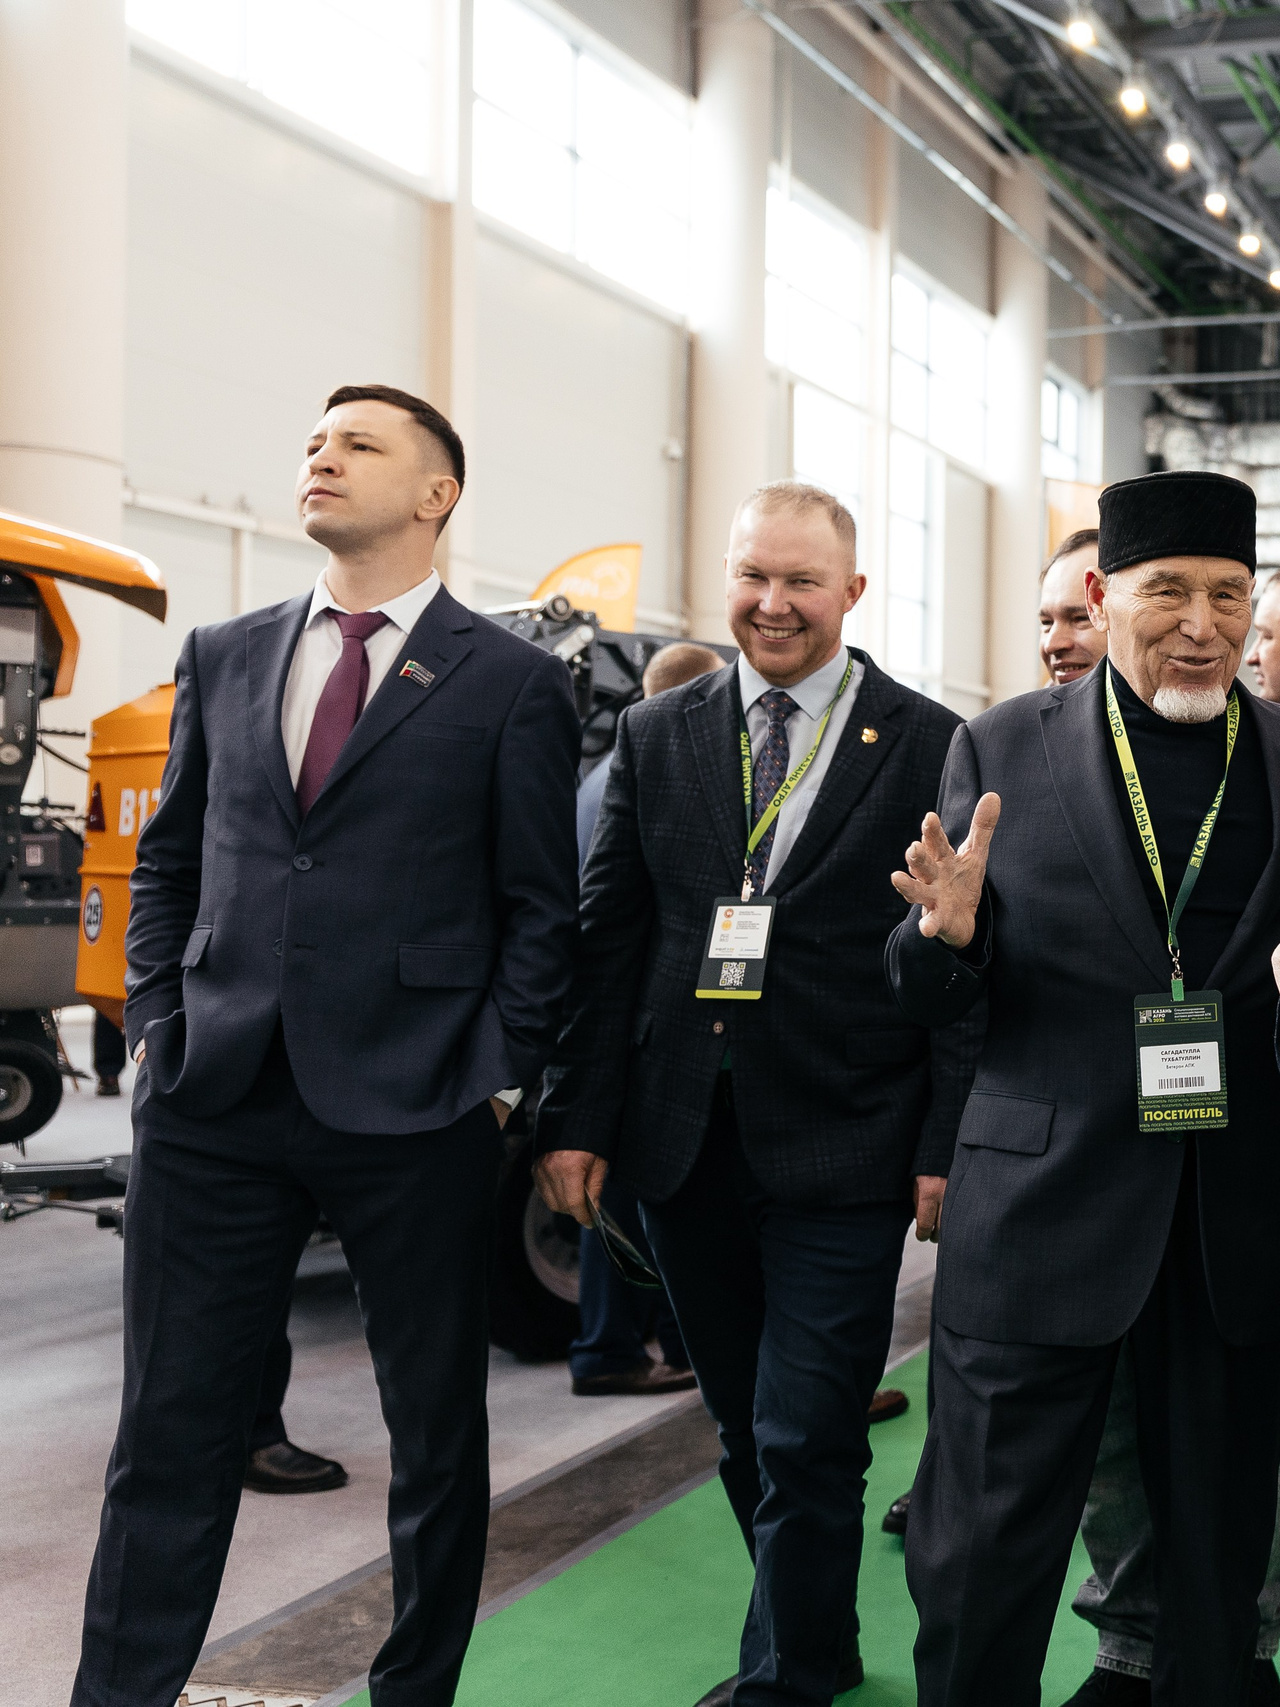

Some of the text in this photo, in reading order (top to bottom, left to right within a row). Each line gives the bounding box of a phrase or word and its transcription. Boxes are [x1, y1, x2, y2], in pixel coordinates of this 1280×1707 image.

[1109, 710, 1124, 738] АГРО
[1228, 703, 1238, 742] КАЗАНЬ
[773, 783, 791, 807] АГРО
[1128, 781, 1158, 866] КАЗАНЬ АГРО
[1193, 780, 1226, 857] КАЗАНЬ АГРО
[1144, 1108, 1223, 1121] ПОСЕТИТЕЛЬ
